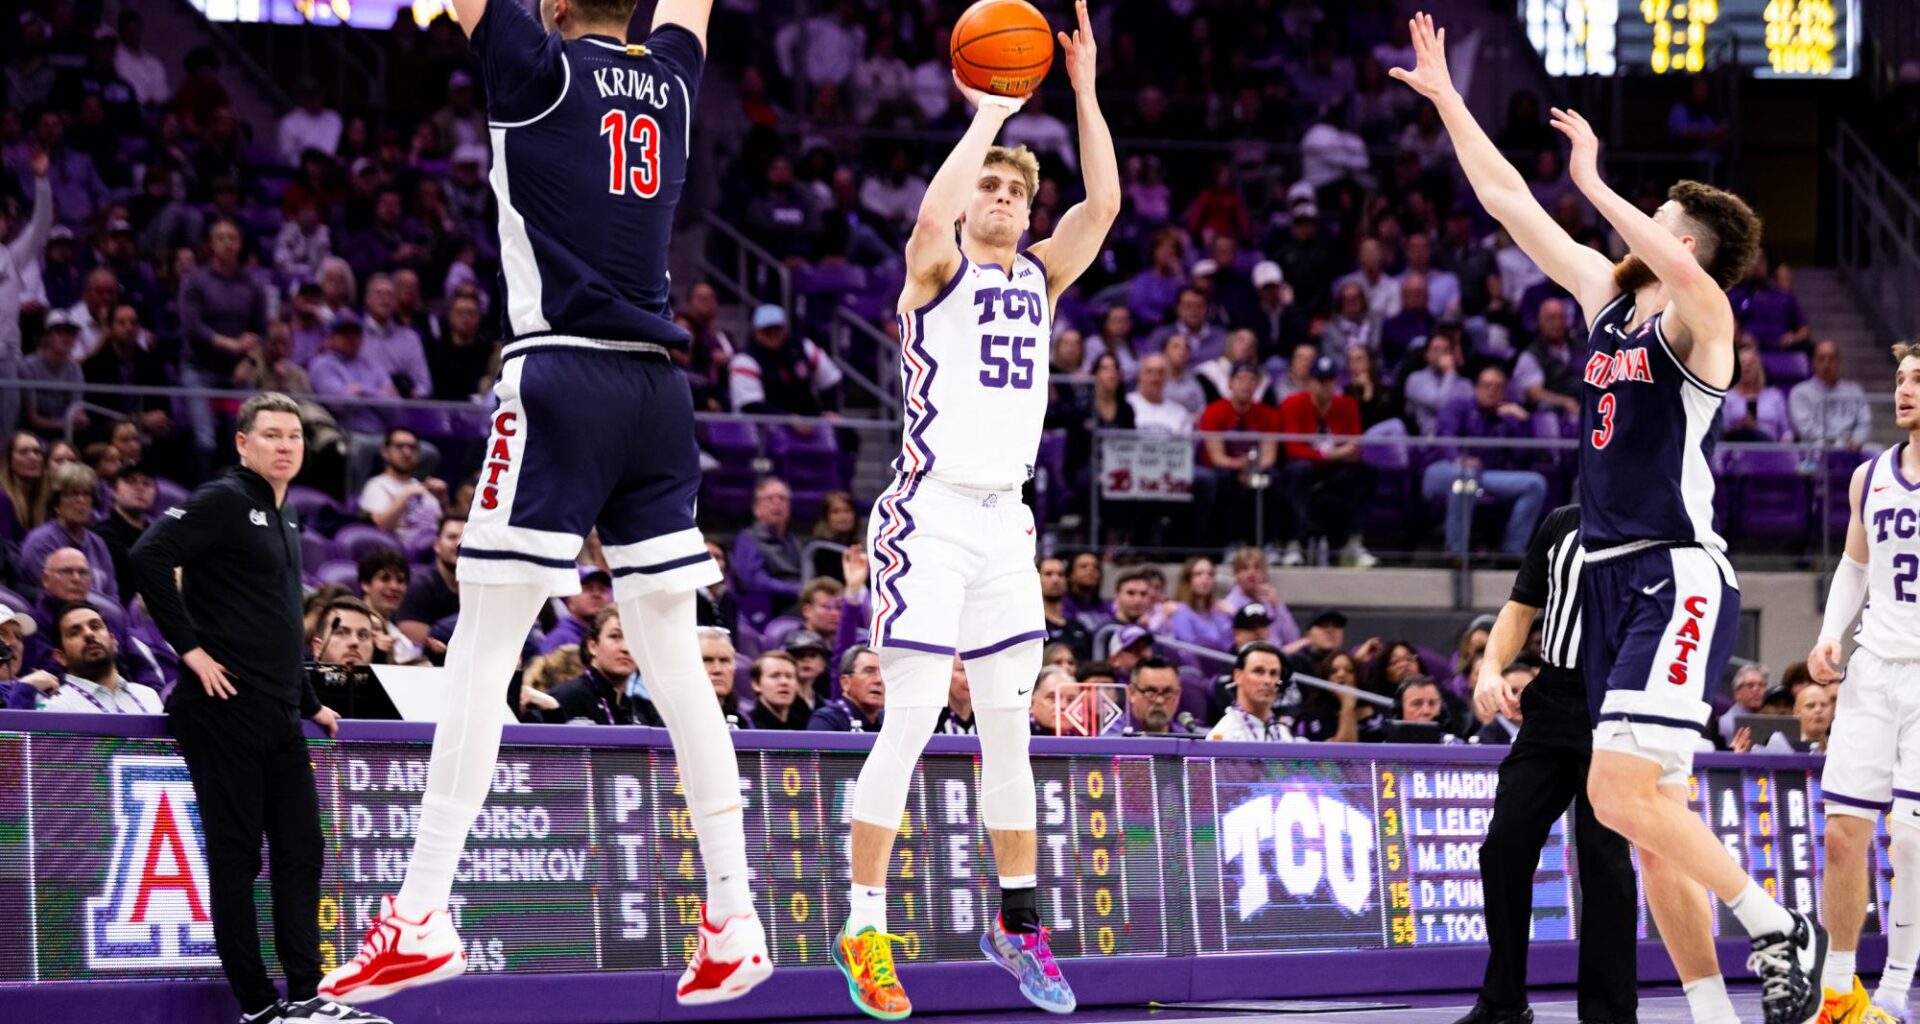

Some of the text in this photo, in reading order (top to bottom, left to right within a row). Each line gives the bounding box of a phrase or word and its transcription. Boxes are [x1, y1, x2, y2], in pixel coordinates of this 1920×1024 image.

[593, 67, 669, 109] KRIVAS
[600, 108, 661, 199] 13
[974, 287, 1042, 327] TCU
[979, 334, 1036, 389] 55
[1592, 392, 1616, 449] 3
[481, 412, 517, 510] CATS
[1873, 508, 1920, 543] TC
[1893, 553, 1919, 603] 2
[1667, 596, 1707, 685] CATS
[349, 760, 379, 791] D.
[1087, 771, 1104, 799] 0
[1382, 773, 1499, 800] 2 B. HARDI
[1757, 778, 1768, 803] 2
[351, 804, 381, 838] D.
[1090, 811, 1107, 839] 0
[1383, 808, 1398, 836] 3
[1415, 808, 1432, 836] L.
[1758, 812, 1771, 837] 0
[375, 848, 586, 881] KHCHENKOV
[899, 848, 915, 878] 2
[1093, 848, 1110, 876] 0
[1222, 791, 1374, 922] TCU
[1386, 845, 1401, 870] 5
[1418, 843, 1441, 871] M.
[1095, 888, 1112, 916] 0
[1388, 880, 1409, 908] 15
[1420, 879, 1439, 908] D.
[1098, 926, 1115, 955] 0
[1391, 915, 1416, 944] 55
[1422, 915, 1441, 943] T.
